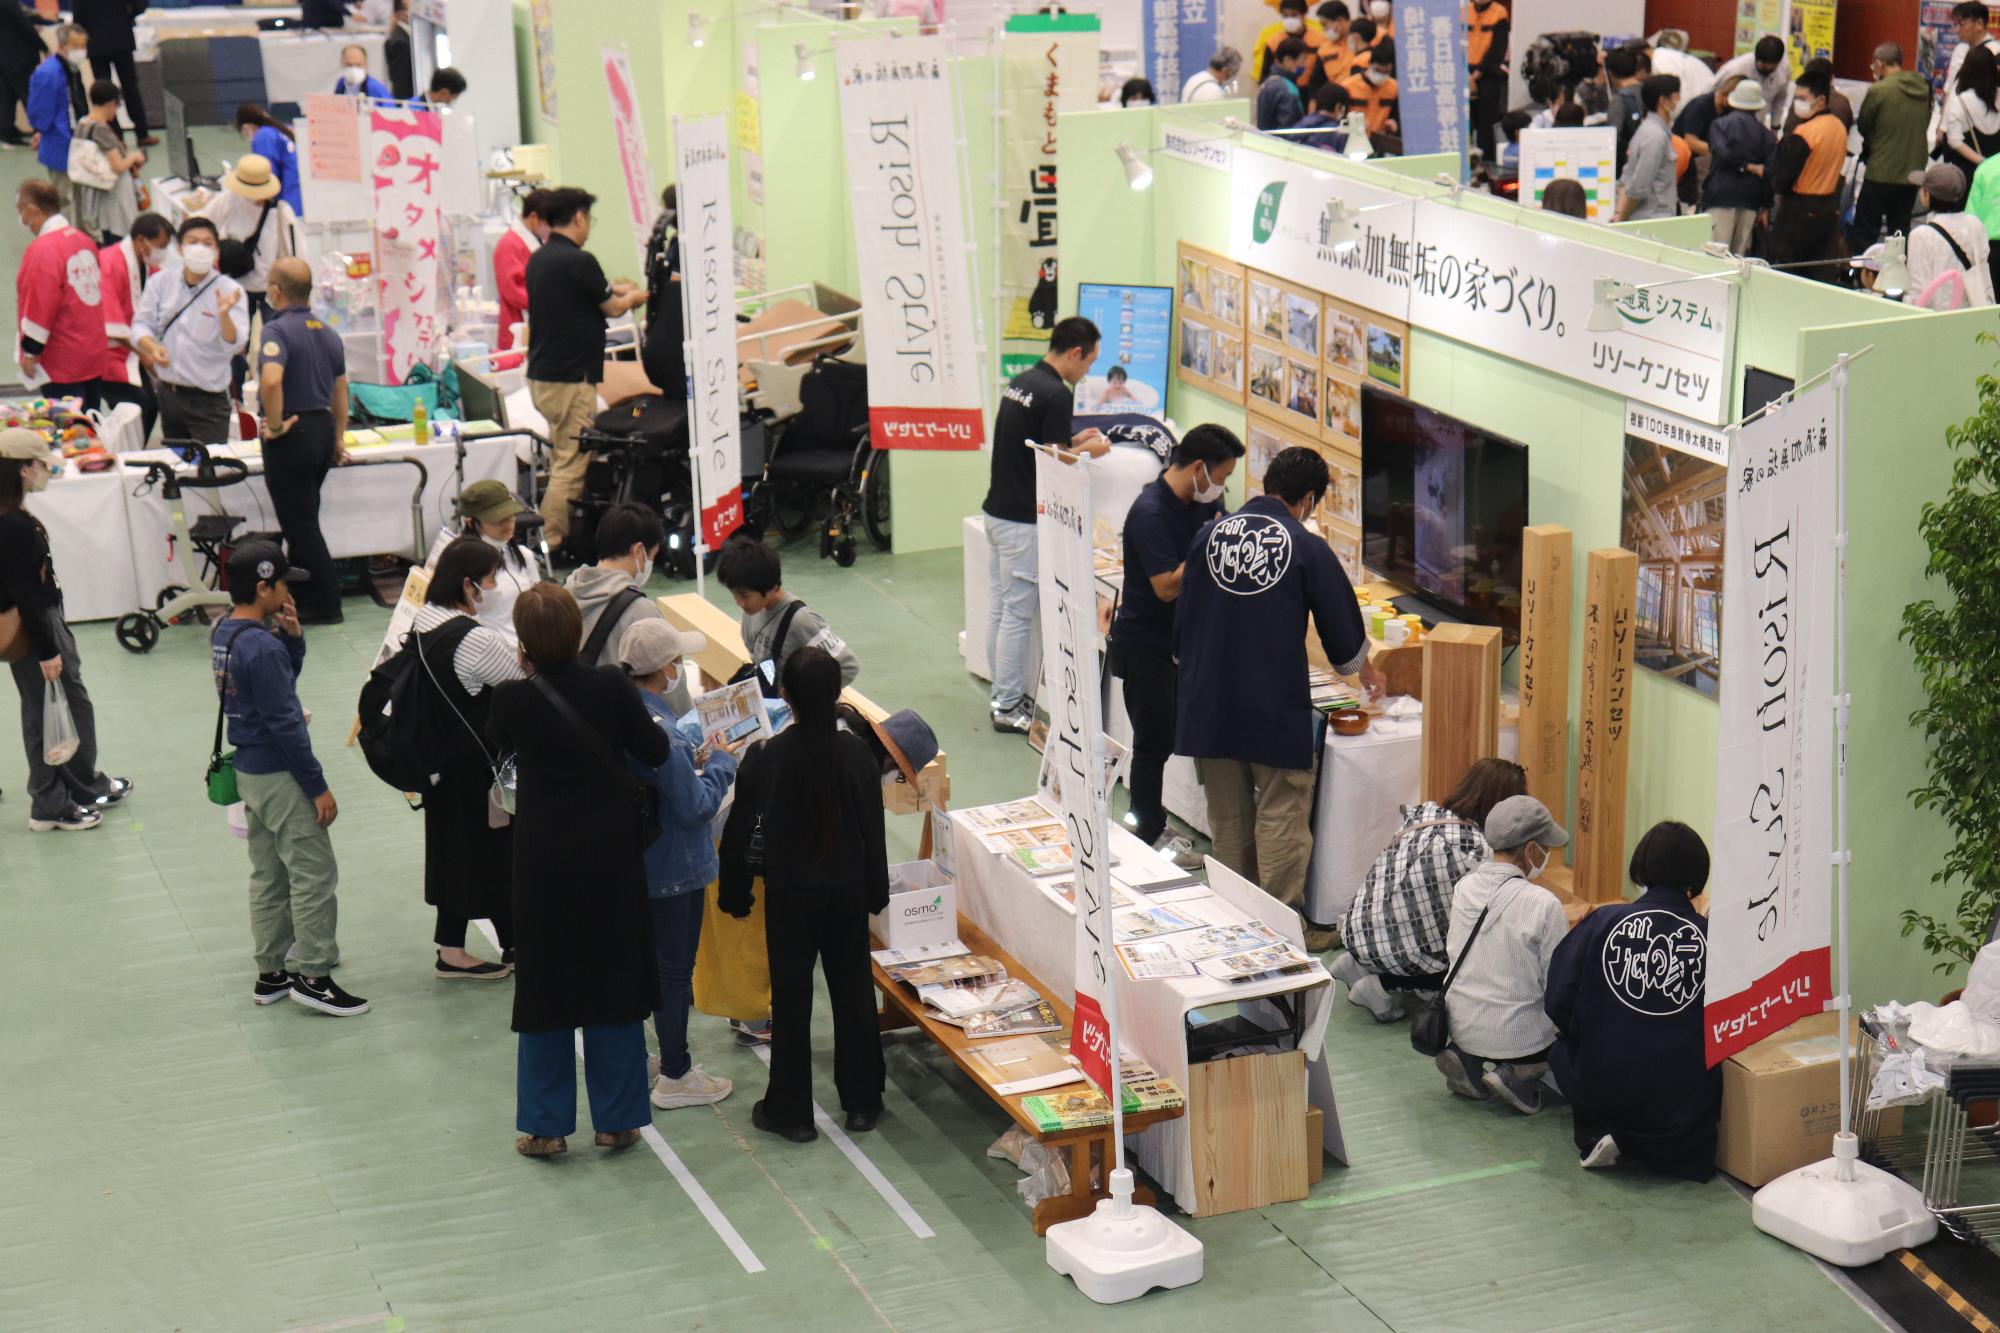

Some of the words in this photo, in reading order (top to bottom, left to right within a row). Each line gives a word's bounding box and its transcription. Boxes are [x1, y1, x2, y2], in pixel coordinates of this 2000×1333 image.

[1656, 293, 1713, 330] システム
[1593, 341, 1710, 402] リソーケンセツ
[1607, 606, 1628, 742] リソーケンセツ
[904, 904, 938, 917] osmo
